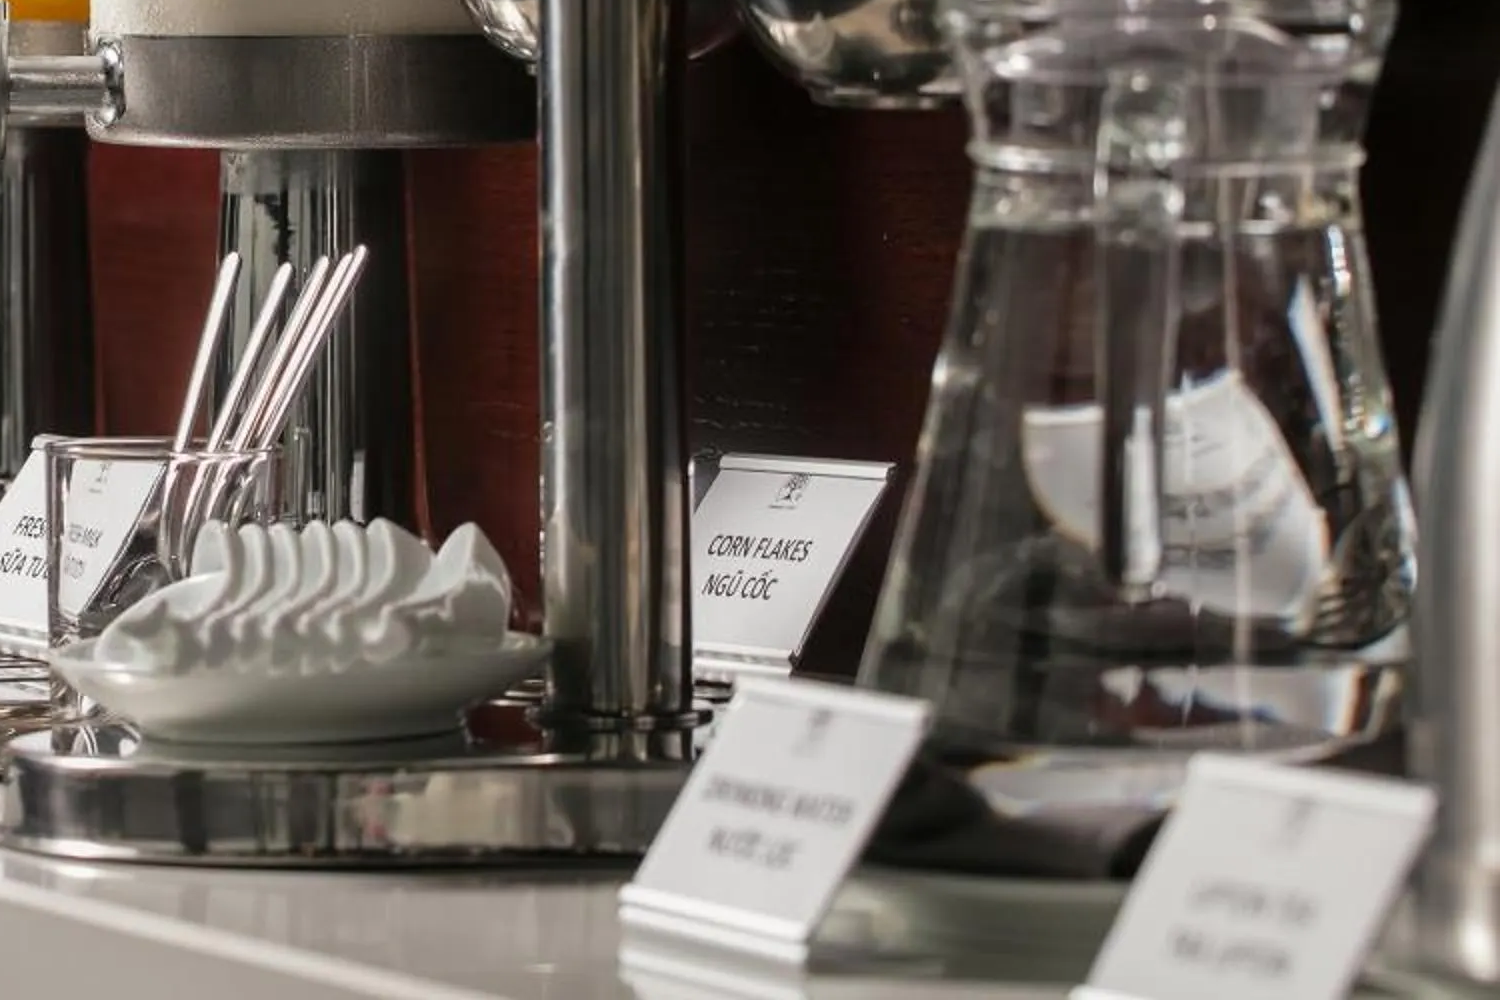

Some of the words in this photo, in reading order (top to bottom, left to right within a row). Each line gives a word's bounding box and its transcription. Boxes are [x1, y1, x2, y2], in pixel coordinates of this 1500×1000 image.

[707, 534, 755, 560] CORN
[753, 537, 813, 562] FLAKES
[701, 569, 743, 598] NGŨ
[741, 569, 778, 600] CỐC
